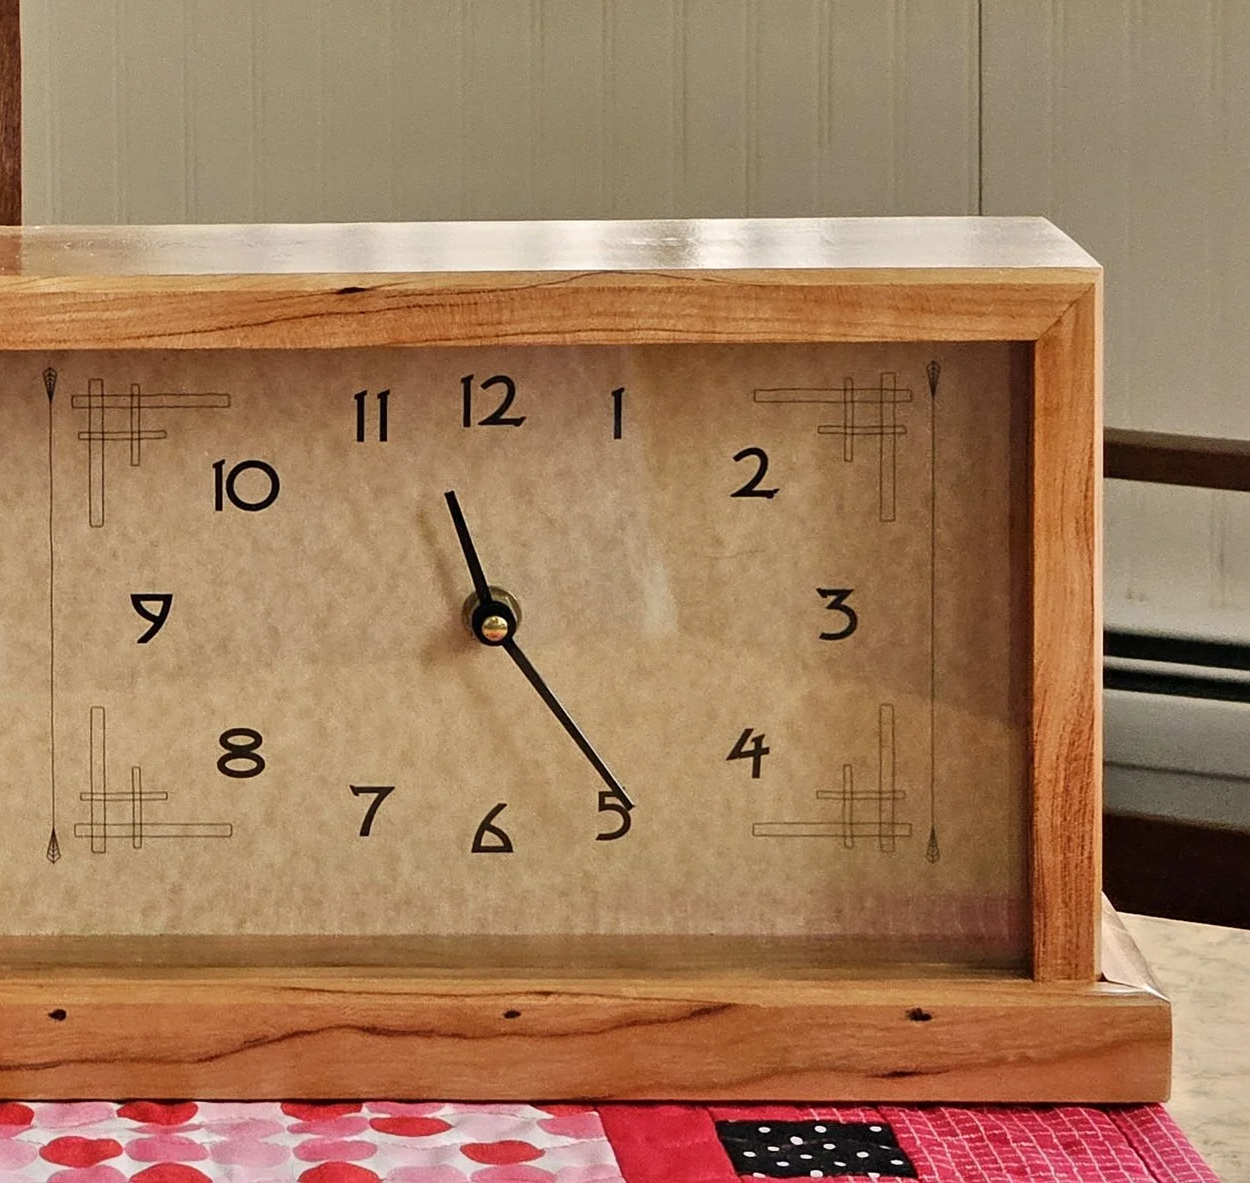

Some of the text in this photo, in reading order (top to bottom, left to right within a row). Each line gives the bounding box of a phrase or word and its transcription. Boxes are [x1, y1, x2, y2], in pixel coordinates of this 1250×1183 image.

[353, 388, 391, 443] 11
[460, 374, 526, 427] 12
[610, 386, 626, 439] 1
[213, 459, 280, 512] 10
[730, 447, 780, 500] 2
[130, 593, 173, 644] 9
[817, 587, 859, 641] 3
[216, 727, 266, 779] 8
[726, 728, 771, 779] 4
[350, 784, 396, 837] 7
[471, 803, 514, 854] 6
[595, 789, 632, 841] 5
